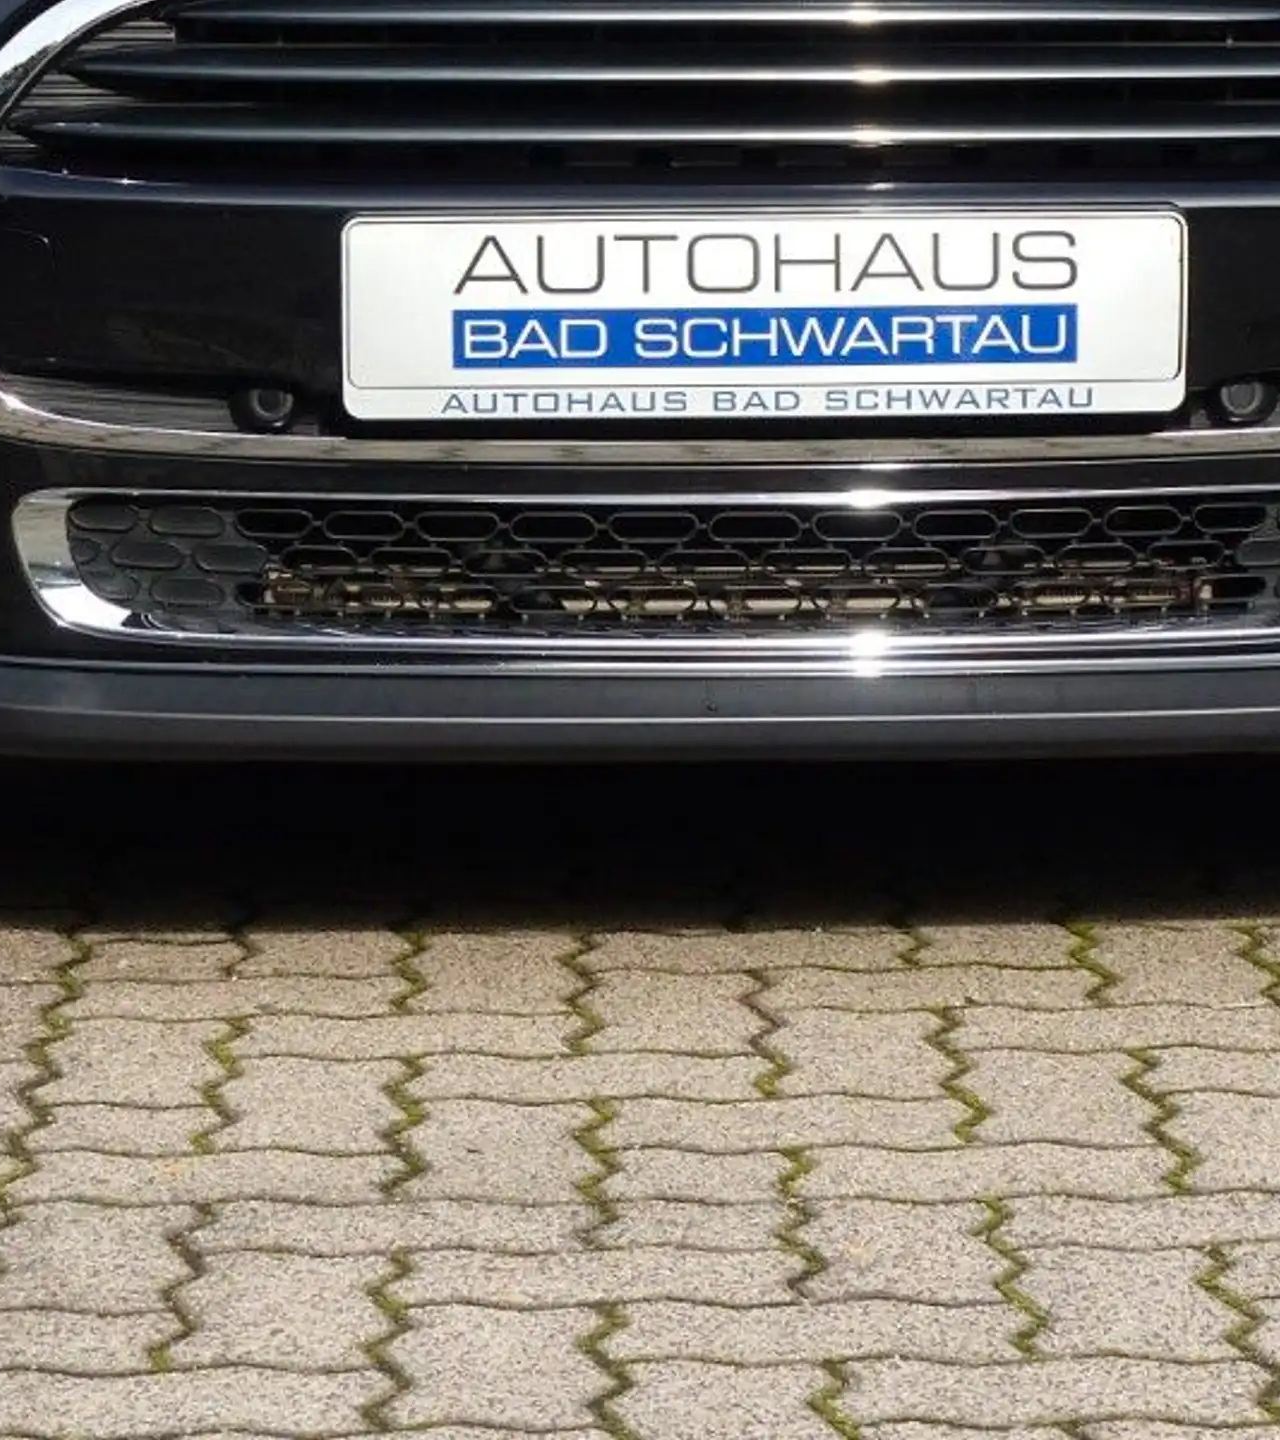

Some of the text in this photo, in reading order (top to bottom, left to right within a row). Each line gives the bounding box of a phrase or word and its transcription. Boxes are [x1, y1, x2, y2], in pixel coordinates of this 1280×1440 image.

[453, 230, 1079, 295] AUTOHAUS
[463, 313, 1067, 360] BAD SCHWARTAU
[441, 387, 1094, 414] AUTOHAUS BAD SCHWARTAU
